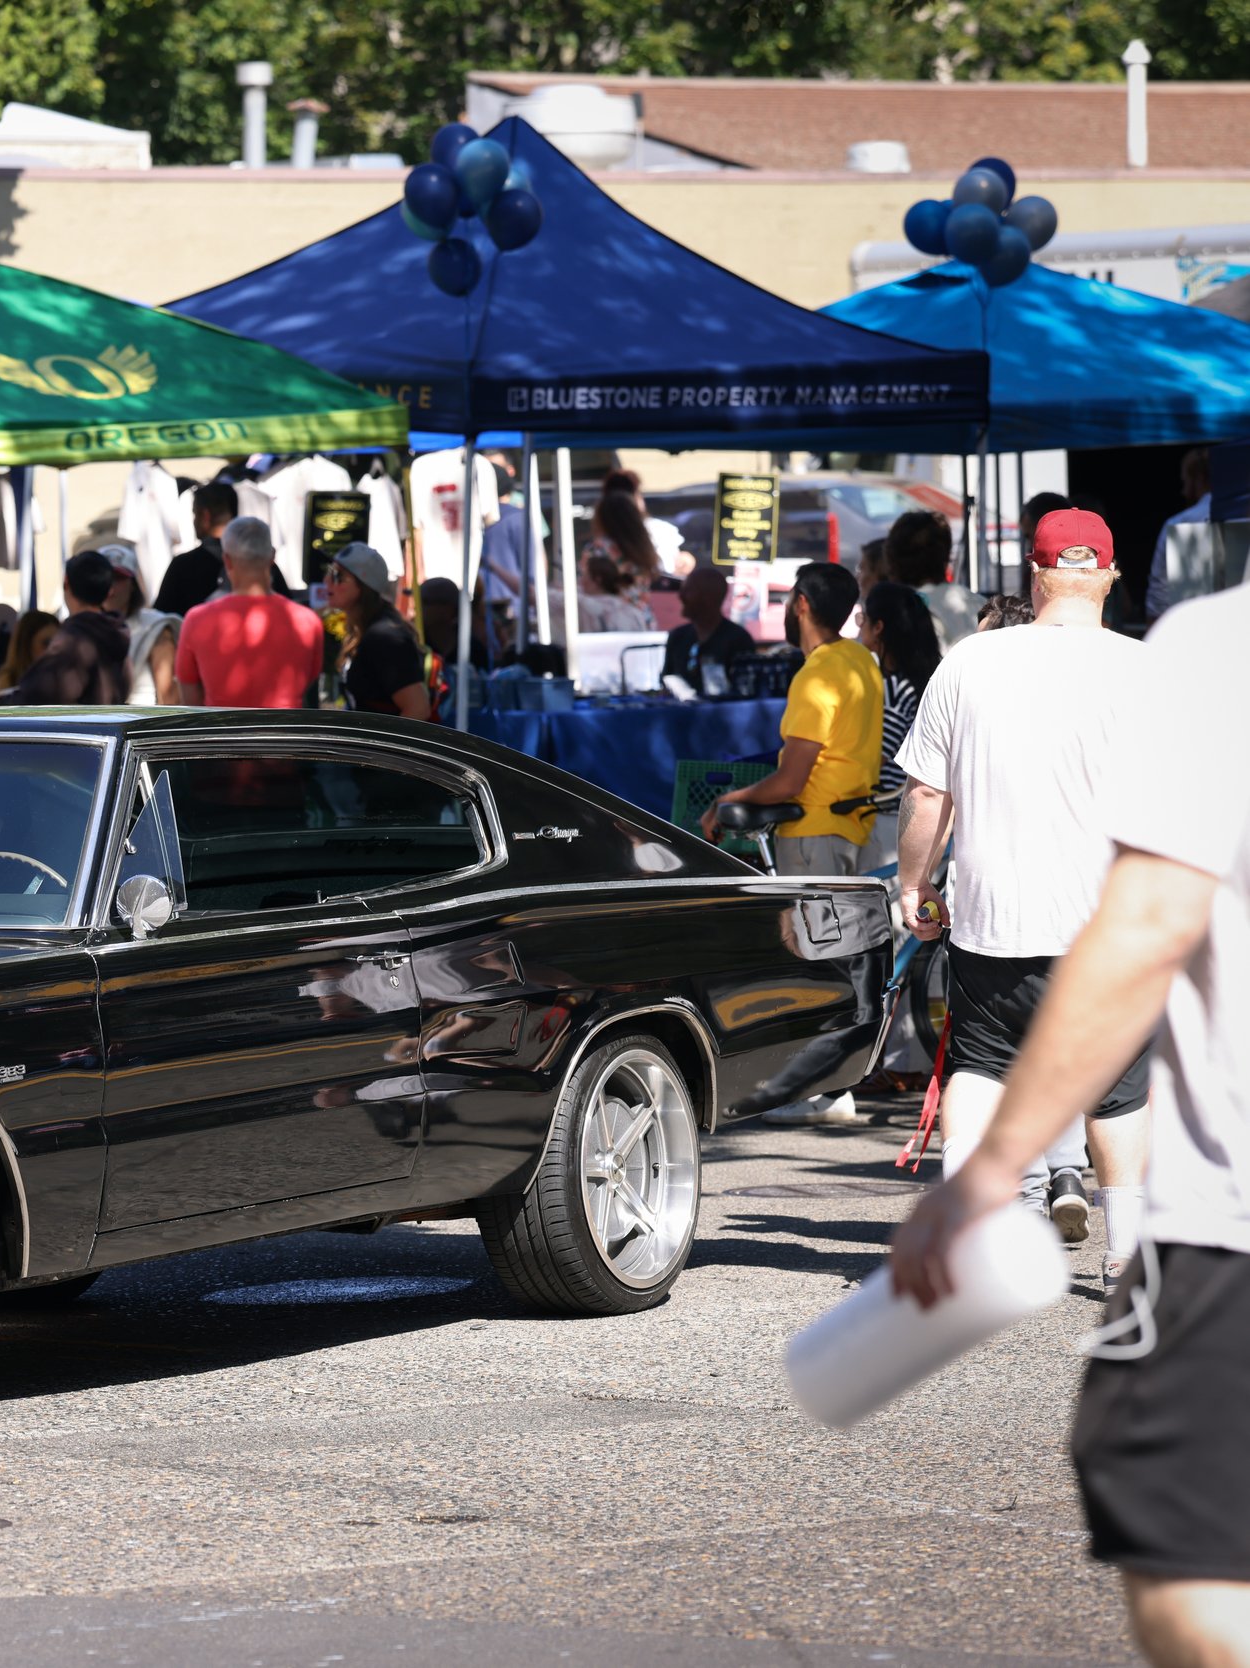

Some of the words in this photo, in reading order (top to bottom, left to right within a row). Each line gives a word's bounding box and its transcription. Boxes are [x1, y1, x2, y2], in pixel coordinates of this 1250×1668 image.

[531, 386, 661, 410] BLUESTONE
[667, 385, 788, 408] PROPERTY
[794, 383, 951, 406] MANAGEMENT
[65, 420, 249, 451] OREGON
